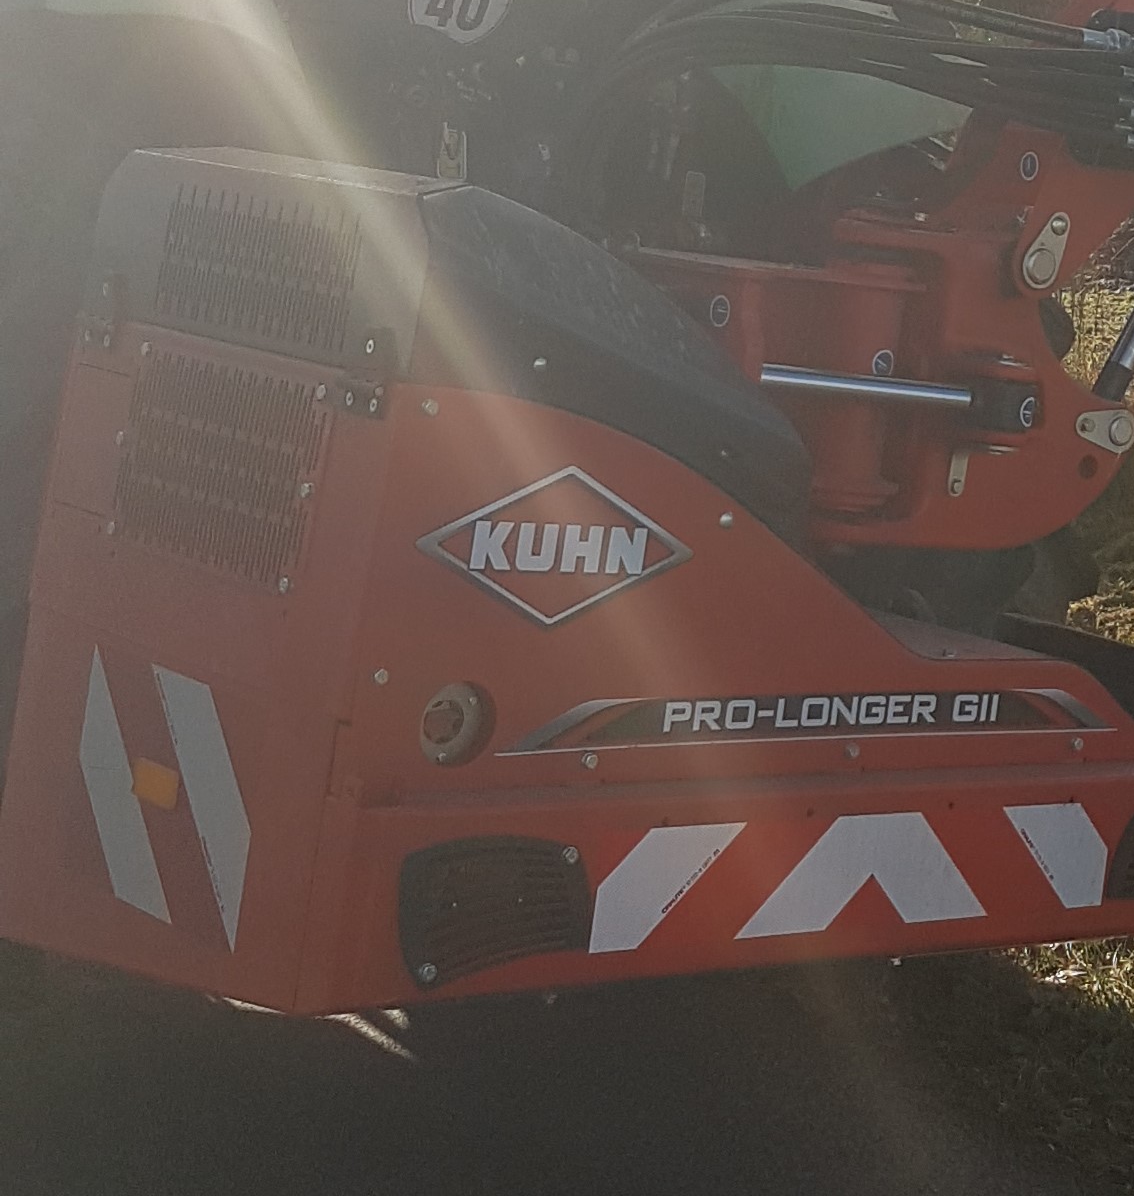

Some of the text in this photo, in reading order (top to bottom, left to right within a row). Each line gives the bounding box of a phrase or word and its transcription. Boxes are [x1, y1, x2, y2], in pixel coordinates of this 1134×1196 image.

[469, 520, 648, 575] KUHN
[663, 693, 1000, 732] PRO-LONGER GII
